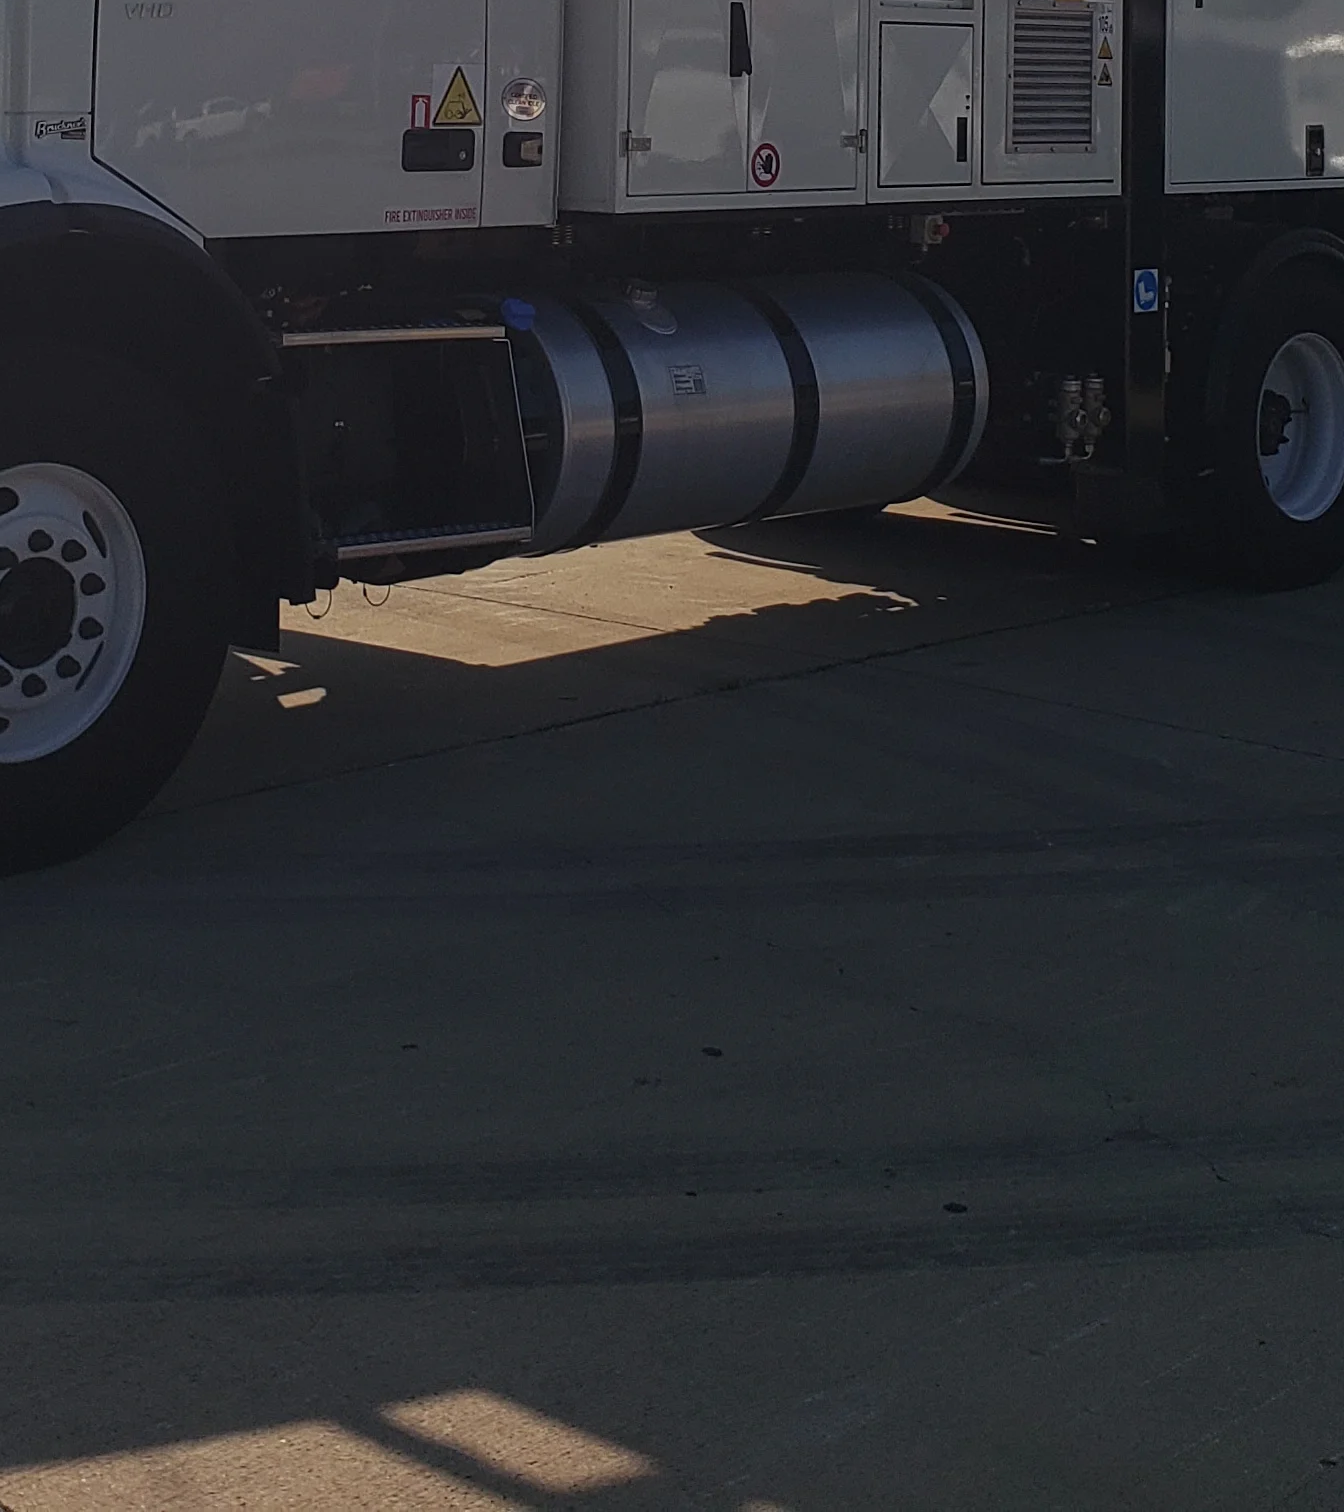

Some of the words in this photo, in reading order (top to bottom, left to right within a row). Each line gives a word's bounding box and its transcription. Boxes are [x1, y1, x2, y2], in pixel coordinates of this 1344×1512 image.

[124, 2, 173, 20] VHD
[385, 210, 401, 223] FIRE
[403, 209, 453, 222] EXTINGUISHER
[454, 207, 477, 220] INSIDE
